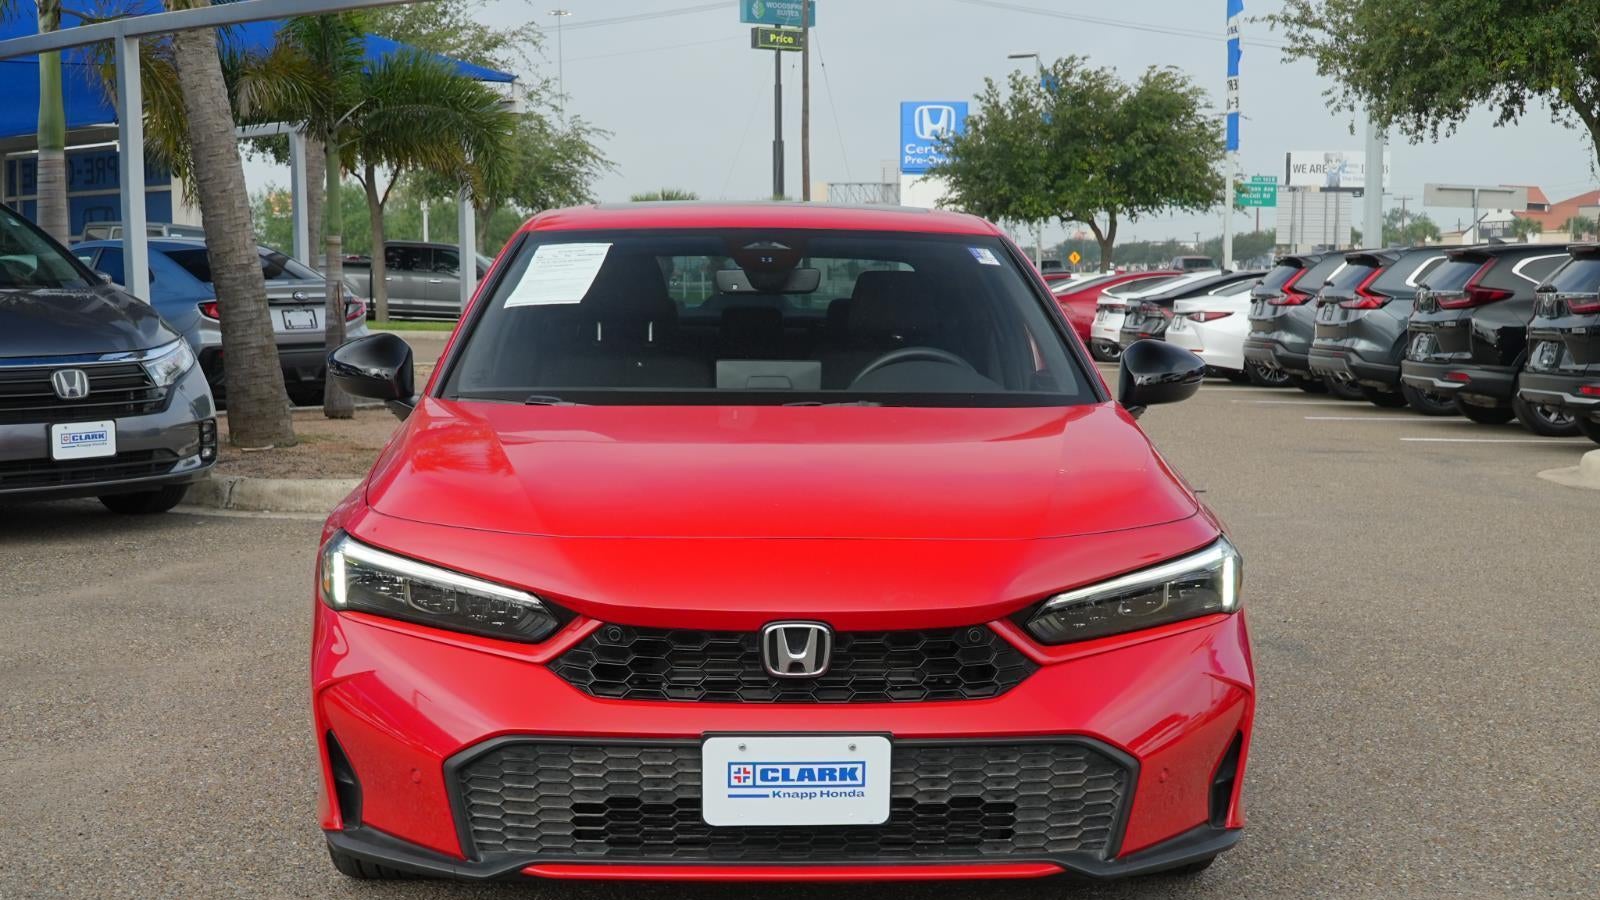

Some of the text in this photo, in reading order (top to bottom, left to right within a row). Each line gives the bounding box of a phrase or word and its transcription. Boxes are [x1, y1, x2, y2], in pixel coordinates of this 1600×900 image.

[769, 33, 794, 44] Price
[1293, 163, 1327, 174] WE ARE
[72, 432, 105, 442] CLARK
[759, 766, 859, 782] CLARK
[772, 789, 866, 800] Knapp Honda
